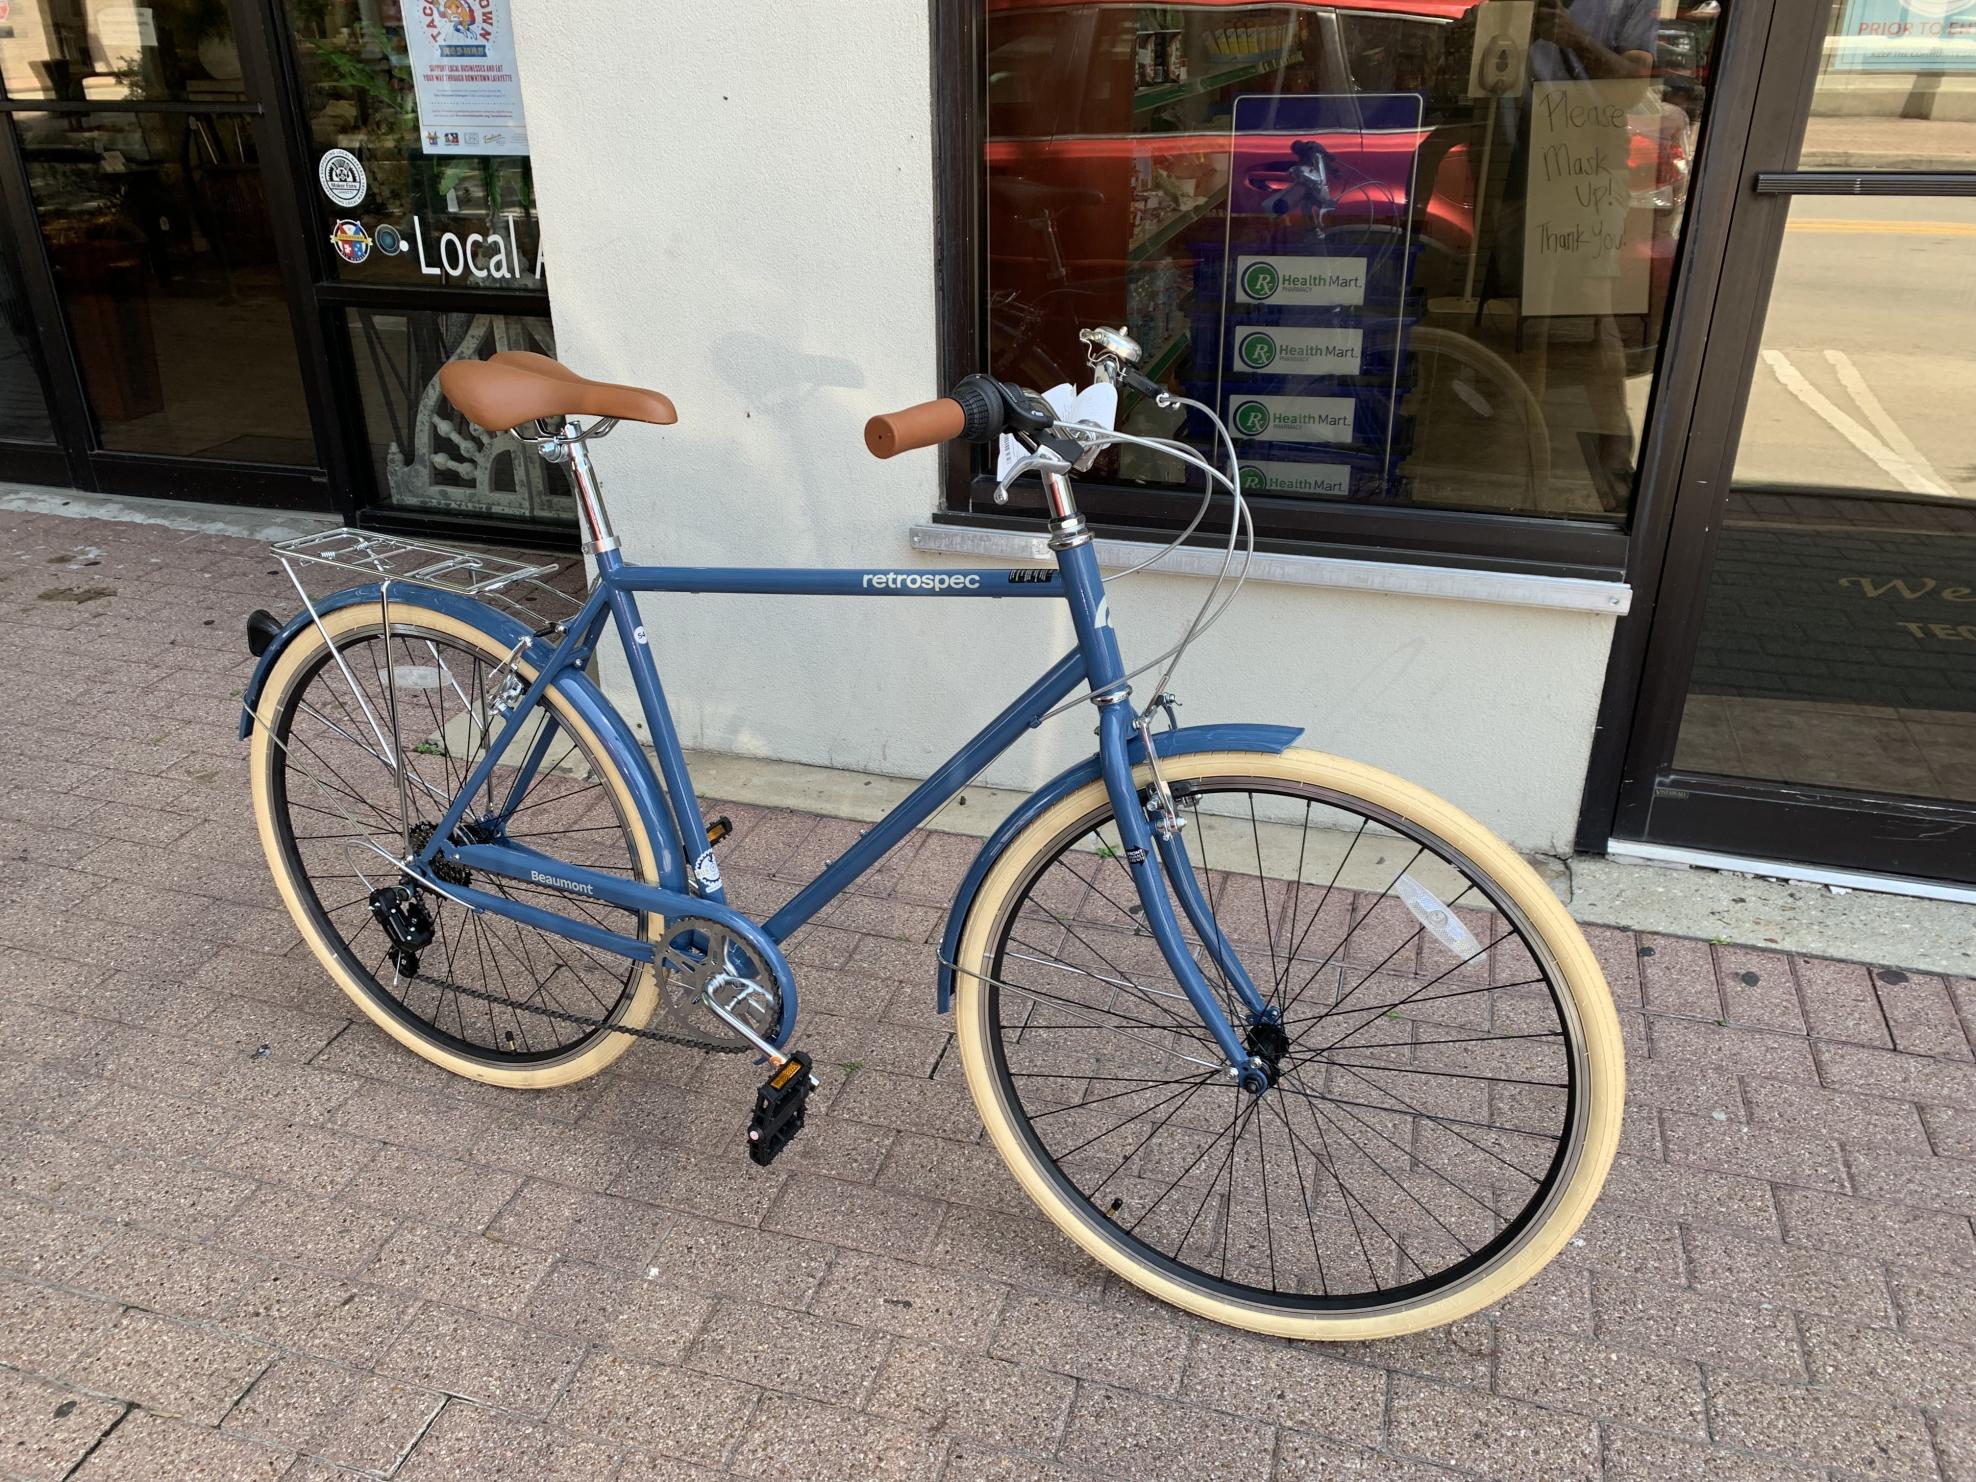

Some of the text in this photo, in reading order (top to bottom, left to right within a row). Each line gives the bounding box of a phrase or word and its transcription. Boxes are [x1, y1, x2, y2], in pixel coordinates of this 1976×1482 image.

[1857, 22, 1914, 36] PRIOR
[1918, 22, 1944, 36] TO
[448, 64, 460, 73] LOCAL
[486, 64, 495, 73] AND
[495, 64, 503, 73] EAT
[423, 74, 513, 83] YOUR WAY THROUGH DOWNTOWN LAFAYETTE
[1539, 90, 1626, 132] Please
[1541, 143, 1612, 182] Mask
[1575, 178, 1613, 216] Up!
[1535, 222, 1590, 254] Thank
[413, 215, 521, 279] Local
[1282, 274, 1360, 288] Health Mart
[1279, 344, 1356, 358] Health Mart
[1273, 412, 1348, 426] Health Mart
[1269, 478, 1343, 492] Health Mart
[862, 571, 981, 592] retrospec
[530, 869, 594, 896] Beaumont
